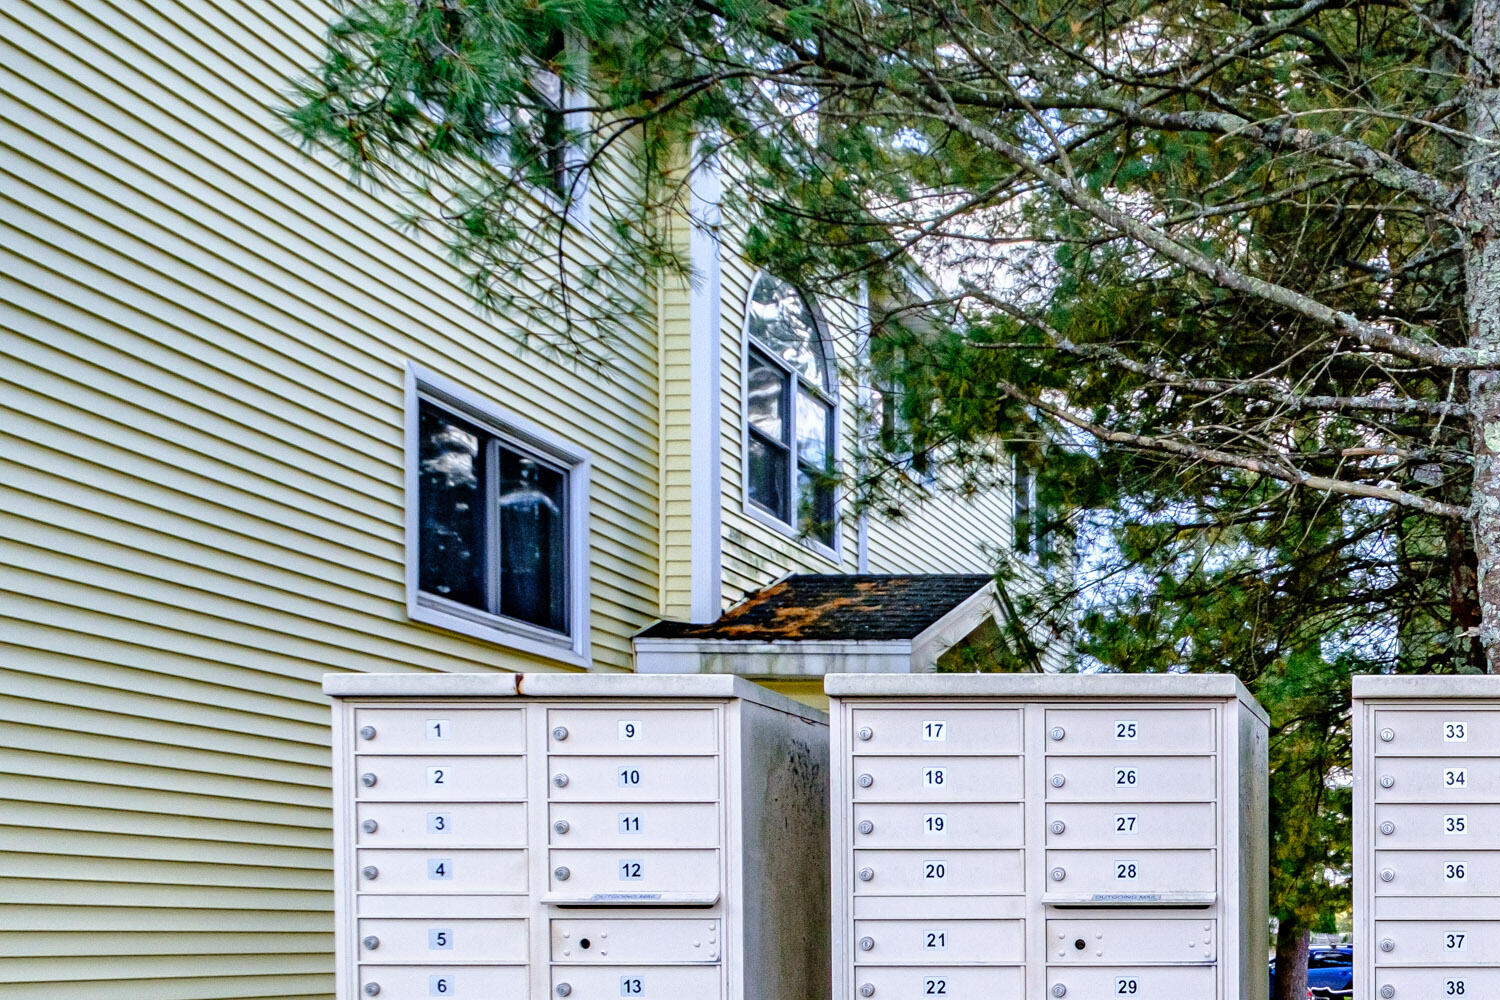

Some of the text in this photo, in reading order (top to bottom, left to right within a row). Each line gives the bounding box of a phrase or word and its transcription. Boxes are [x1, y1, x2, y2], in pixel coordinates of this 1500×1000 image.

[433, 723, 441, 738] 1
[625, 723, 635, 738] 9
[925, 723, 944, 738] 17
[1116, 723, 1137, 738] 25
[1446, 724, 1465, 739] 33
[434, 769, 444, 784] 2
[620, 769, 640, 785] 10
[925, 770, 944, 785] 18
[1116, 770, 1136, 785] 26
[1446, 771, 1465, 786] 34
[435, 816, 445, 831] 3
[622, 816, 639, 832] 11
[926, 817, 944, 832] 19
[1116, 817, 1136, 832] 27
[1446, 817, 1465, 832] 35
[435, 862, 446, 877] 4
[622, 863, 641, 878] 12
[925, 863, 945, 879] 20
[1117, 863, 1137, 879] 28
[1446, 864, 1465, 879] 36
[436, 932, 447, 947] 5
[927, 932, 945, 948] 21
[1446, 934, 1465, 949] 37
[437, 978, 447, 993] 6
[623, 979, 642, 994] 13
[926, 979, 947, 995] 22
[1117, 979, 1138, 995] 29
[1446, 980, 1465, 996] 38
